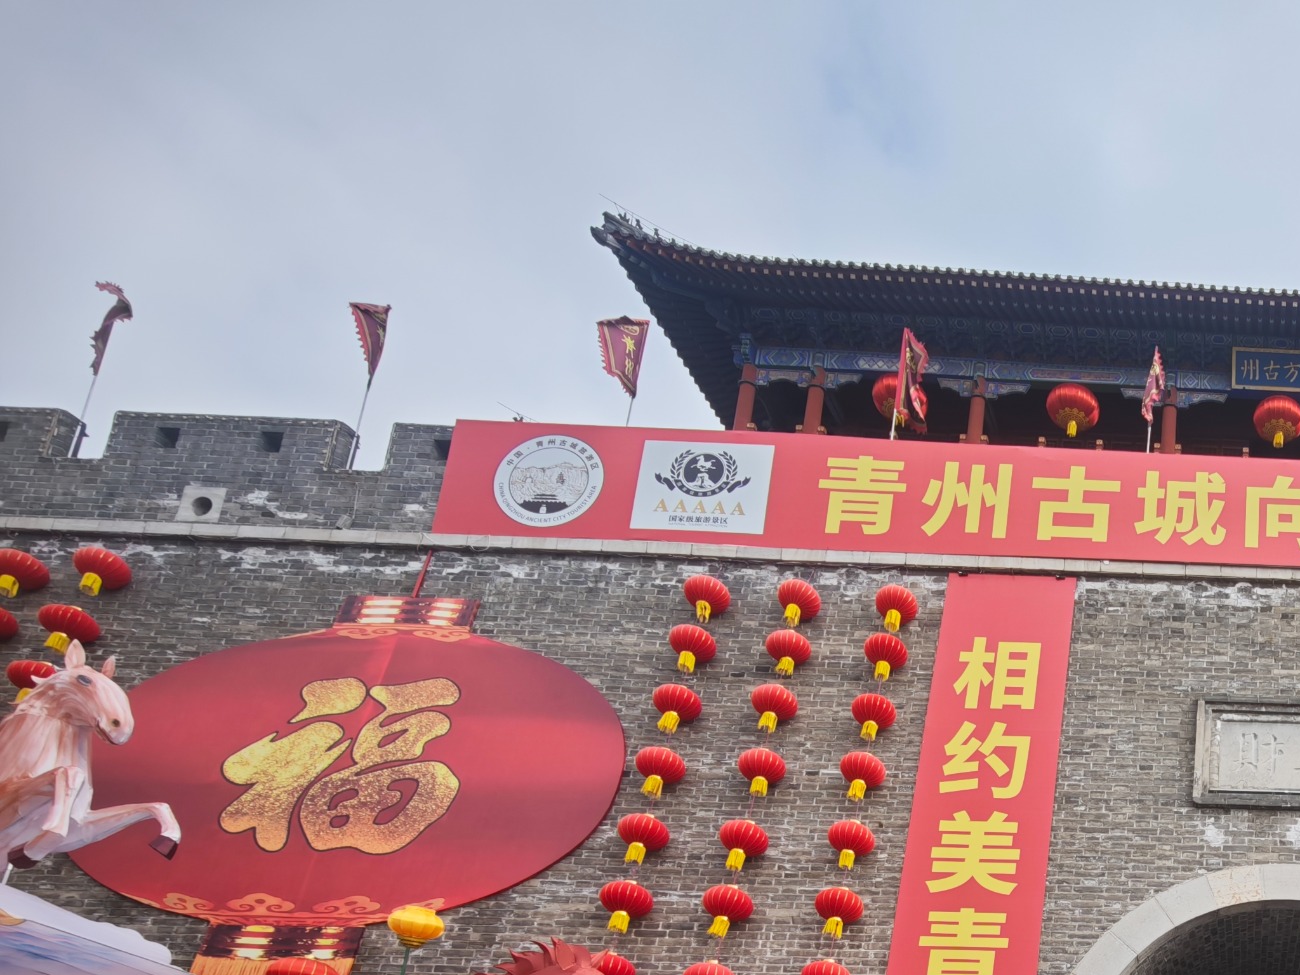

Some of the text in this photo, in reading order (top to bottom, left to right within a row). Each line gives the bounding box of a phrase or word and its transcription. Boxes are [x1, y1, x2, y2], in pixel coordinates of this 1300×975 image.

[525, 515, 552, 524] ANCIENT
[552, 514, 566, 522] CITY
[567, 499, 589, 516] TOURIST
[219, 676, 462, 855] 福
